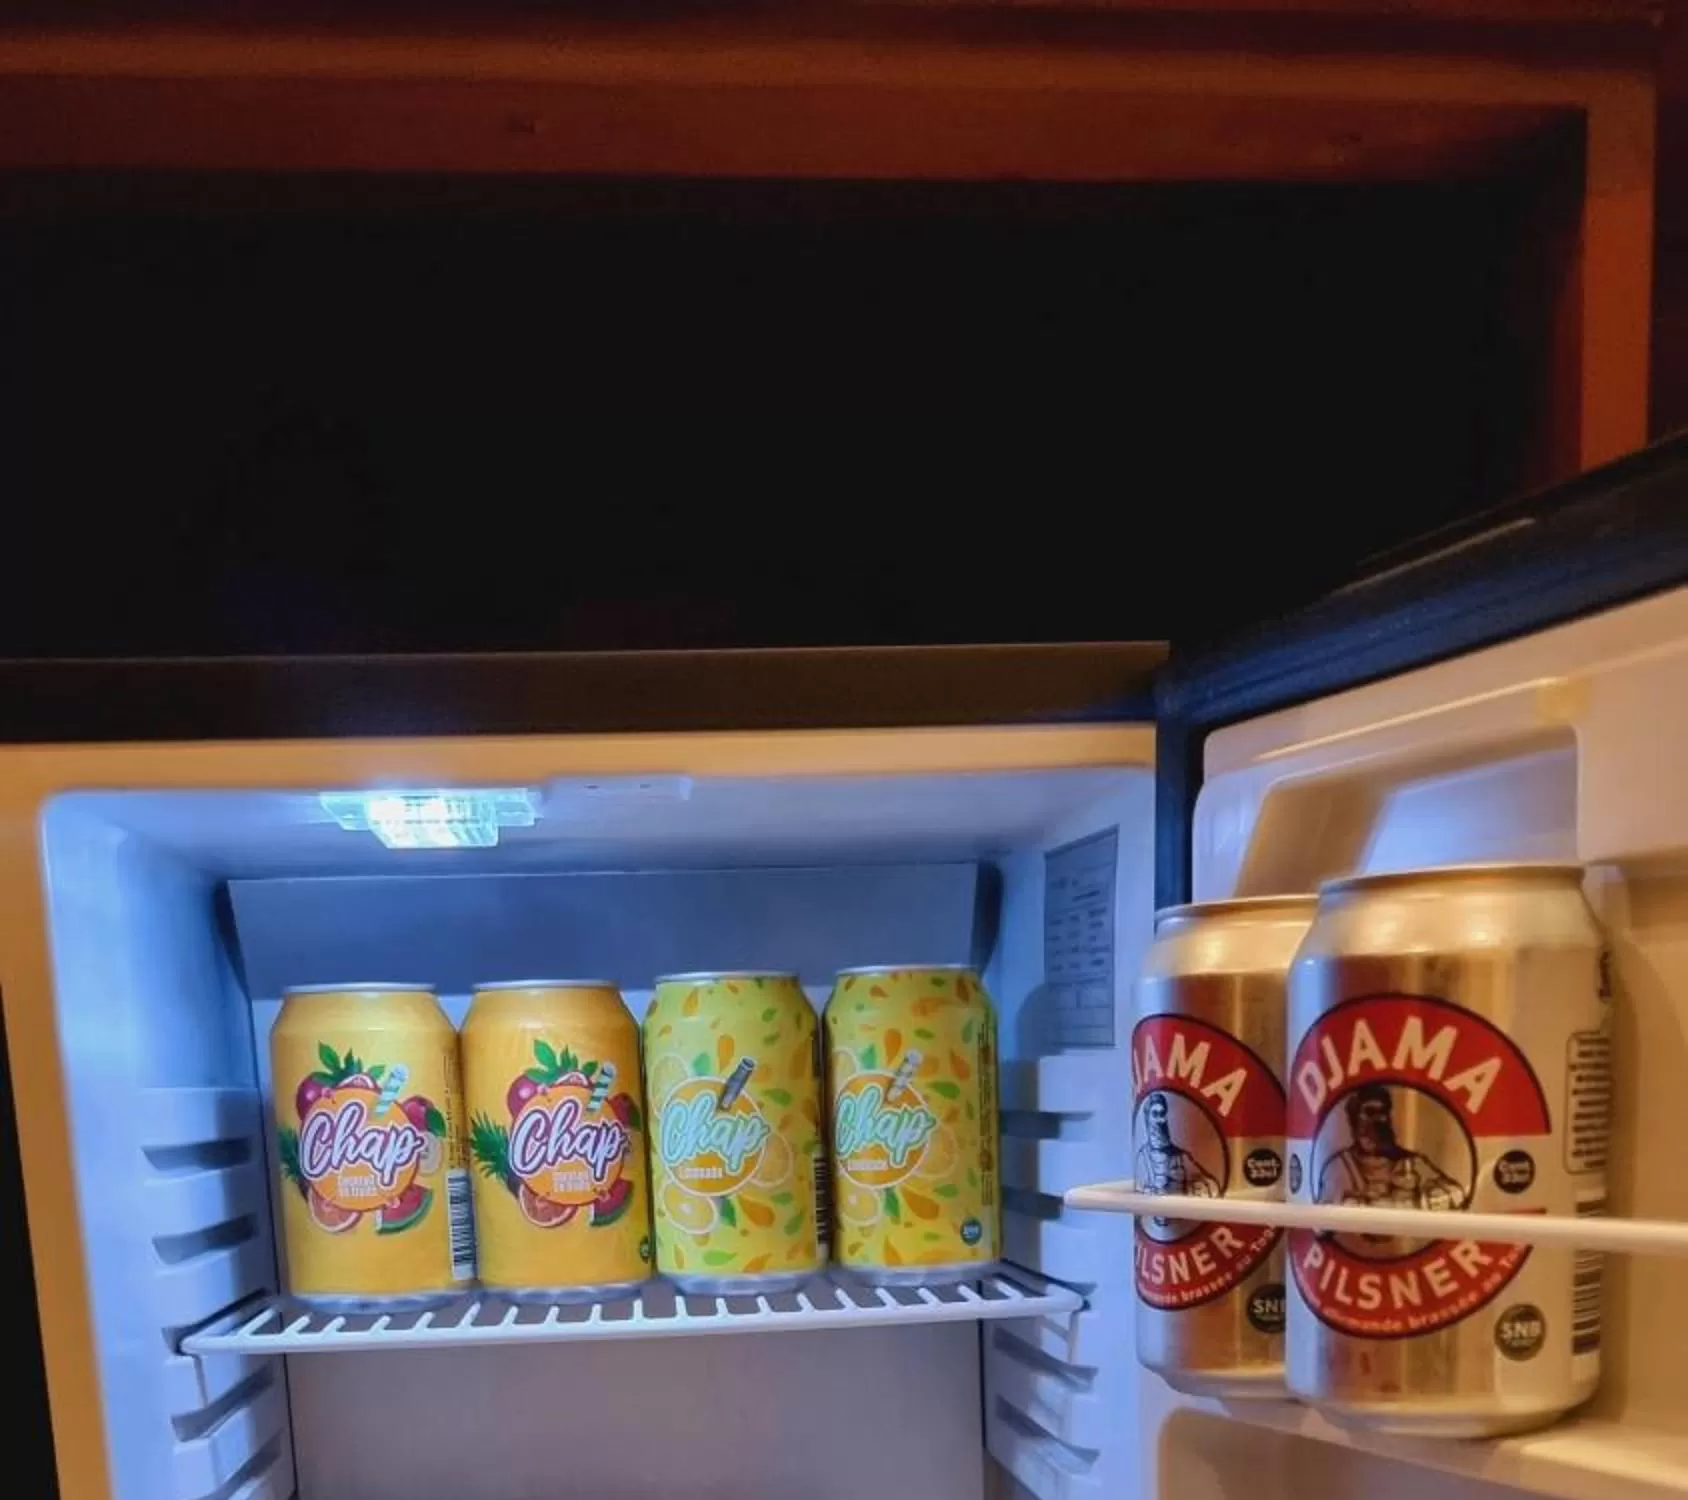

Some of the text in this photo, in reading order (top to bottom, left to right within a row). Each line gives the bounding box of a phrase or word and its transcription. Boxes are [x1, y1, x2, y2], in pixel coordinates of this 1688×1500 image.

[1133, 1032, 1248, 1118] JAMA
[1297, 1014, 1504, 1114] DJAMA
[302, 1101, 424, 1186] Chap
[510, 1100, 626, 1181] Chap
[661, 1086, 770, 1173] Chap
[836, 1086, 936, 1167] Chap
[1135, 1226, 1246, 1286] ILSNER
[1302, 1239, 1493, 1311] PILSNER
